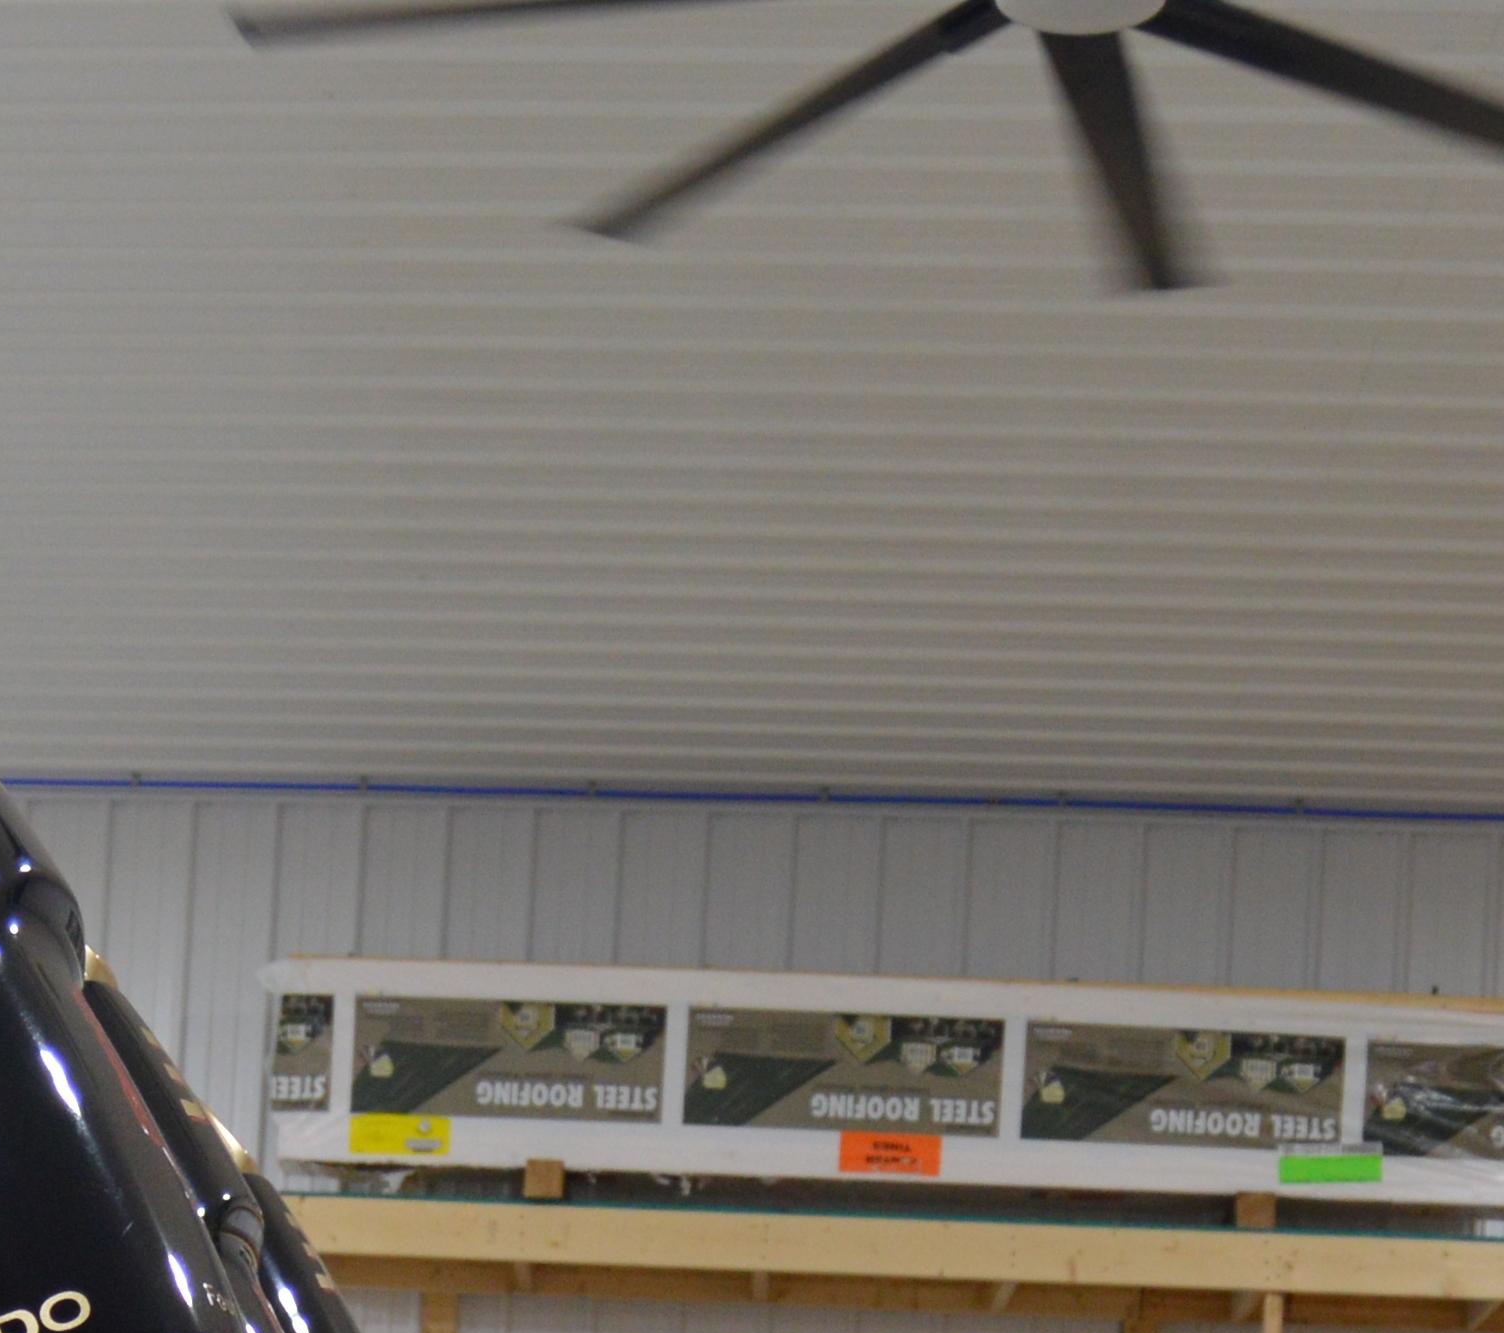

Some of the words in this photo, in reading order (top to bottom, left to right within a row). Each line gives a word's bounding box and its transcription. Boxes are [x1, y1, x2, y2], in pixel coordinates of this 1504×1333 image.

[475, 1080, 583, 1108] ROOFING
[592, 1084, 657, 1112] STEEL
[810, 1093, 920, 1121] ROOFING
[930, 1098, 995, 1124] STEEL
[1149, 1108, 1261, 1137] ROOFING
[1271, 1114, 1338, 1140] STEEL
